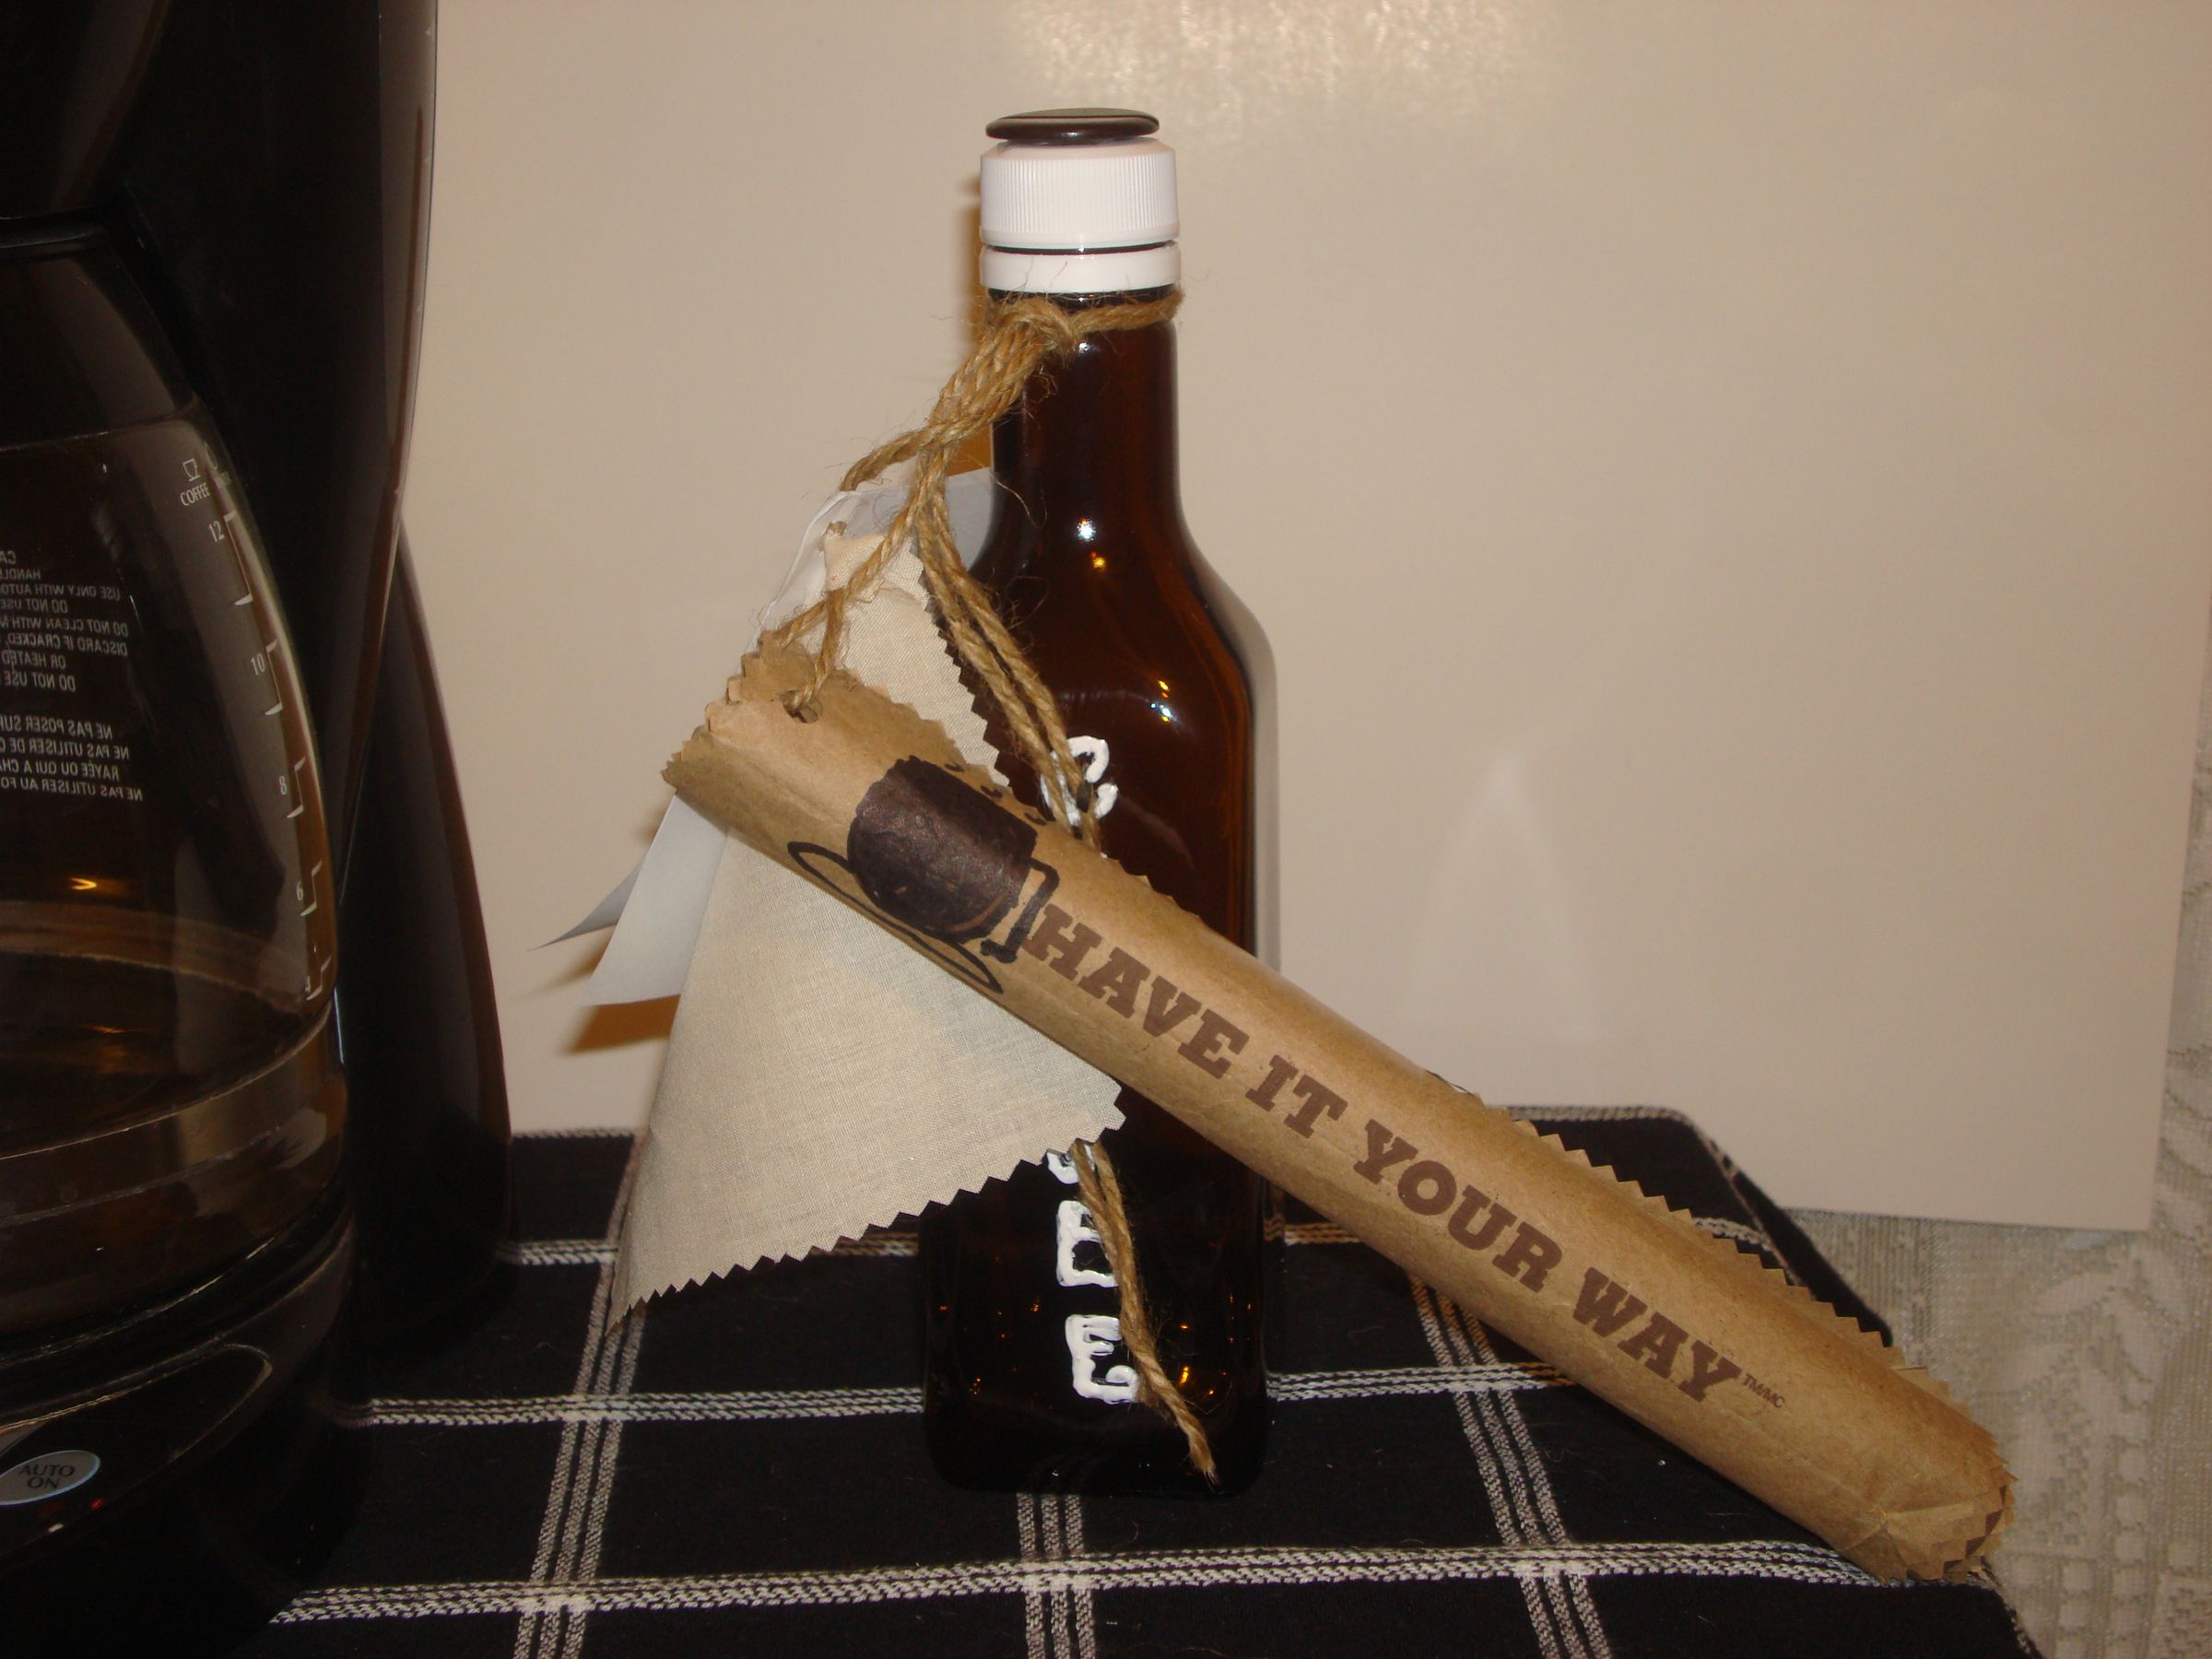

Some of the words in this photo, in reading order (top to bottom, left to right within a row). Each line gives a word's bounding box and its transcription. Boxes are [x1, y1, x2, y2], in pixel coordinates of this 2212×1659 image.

[181, 482, 210, 506] COFFEE
[208, 520, 225, 542] 12
[251, 653, 266, 676] 10
[279, 775, 288, 795] 8
[296, 880, 303, 901] 6
[304, 975, 312, 994] 4
[1021, 902, 1250, 1079] HAVE
[1245, 1054, 1348, 1139] IT
[1352, 1118, 1563, 1294] YOUR
[1572, 1266, 1742, 1402] WAY
[18, 1464, 75, 1477] AUTO
[27, 1477, 60, 1489] ON
